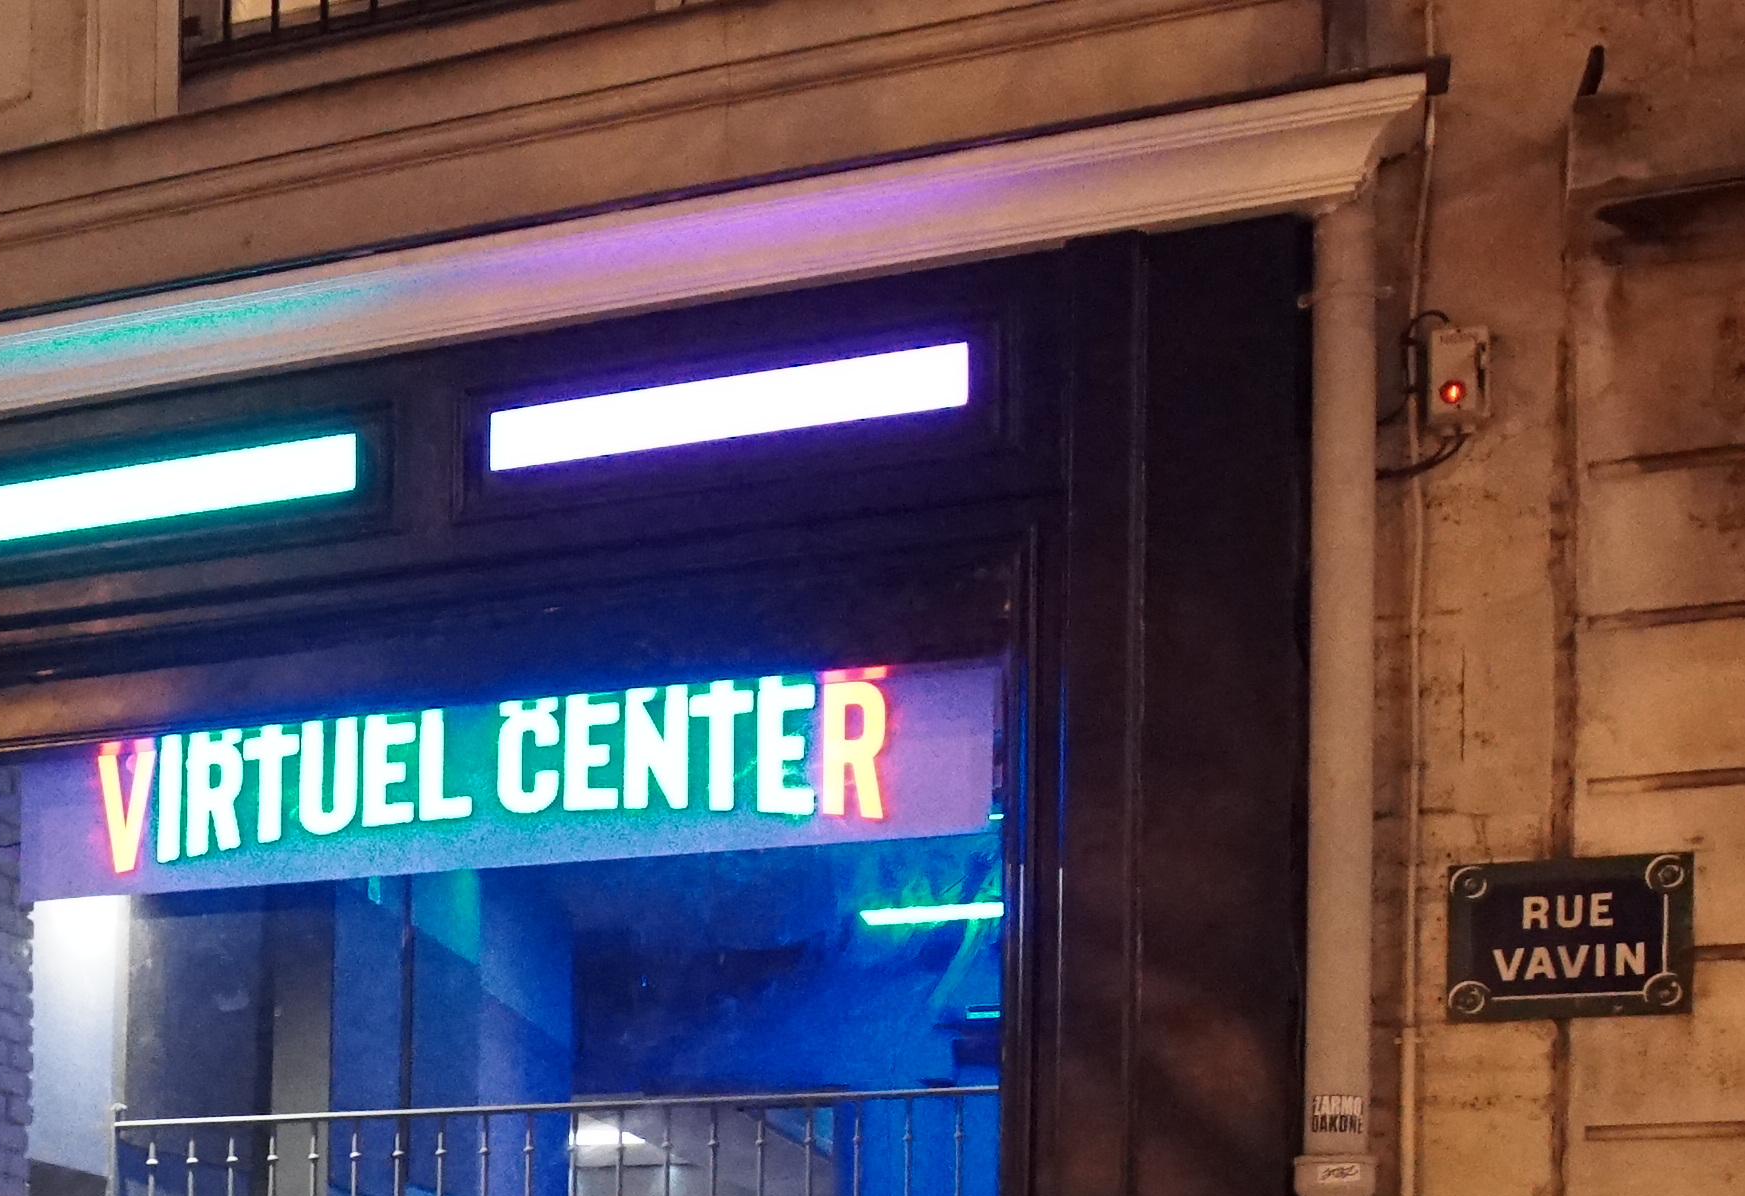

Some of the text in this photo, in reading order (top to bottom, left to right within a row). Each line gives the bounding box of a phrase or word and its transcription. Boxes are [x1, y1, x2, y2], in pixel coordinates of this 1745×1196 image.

[96, 664, 890, 875] VIRTUEL CENTER
[1521, 891, 1614, 930] RUE
[1493, 941, 1646, 982] VAVIN
